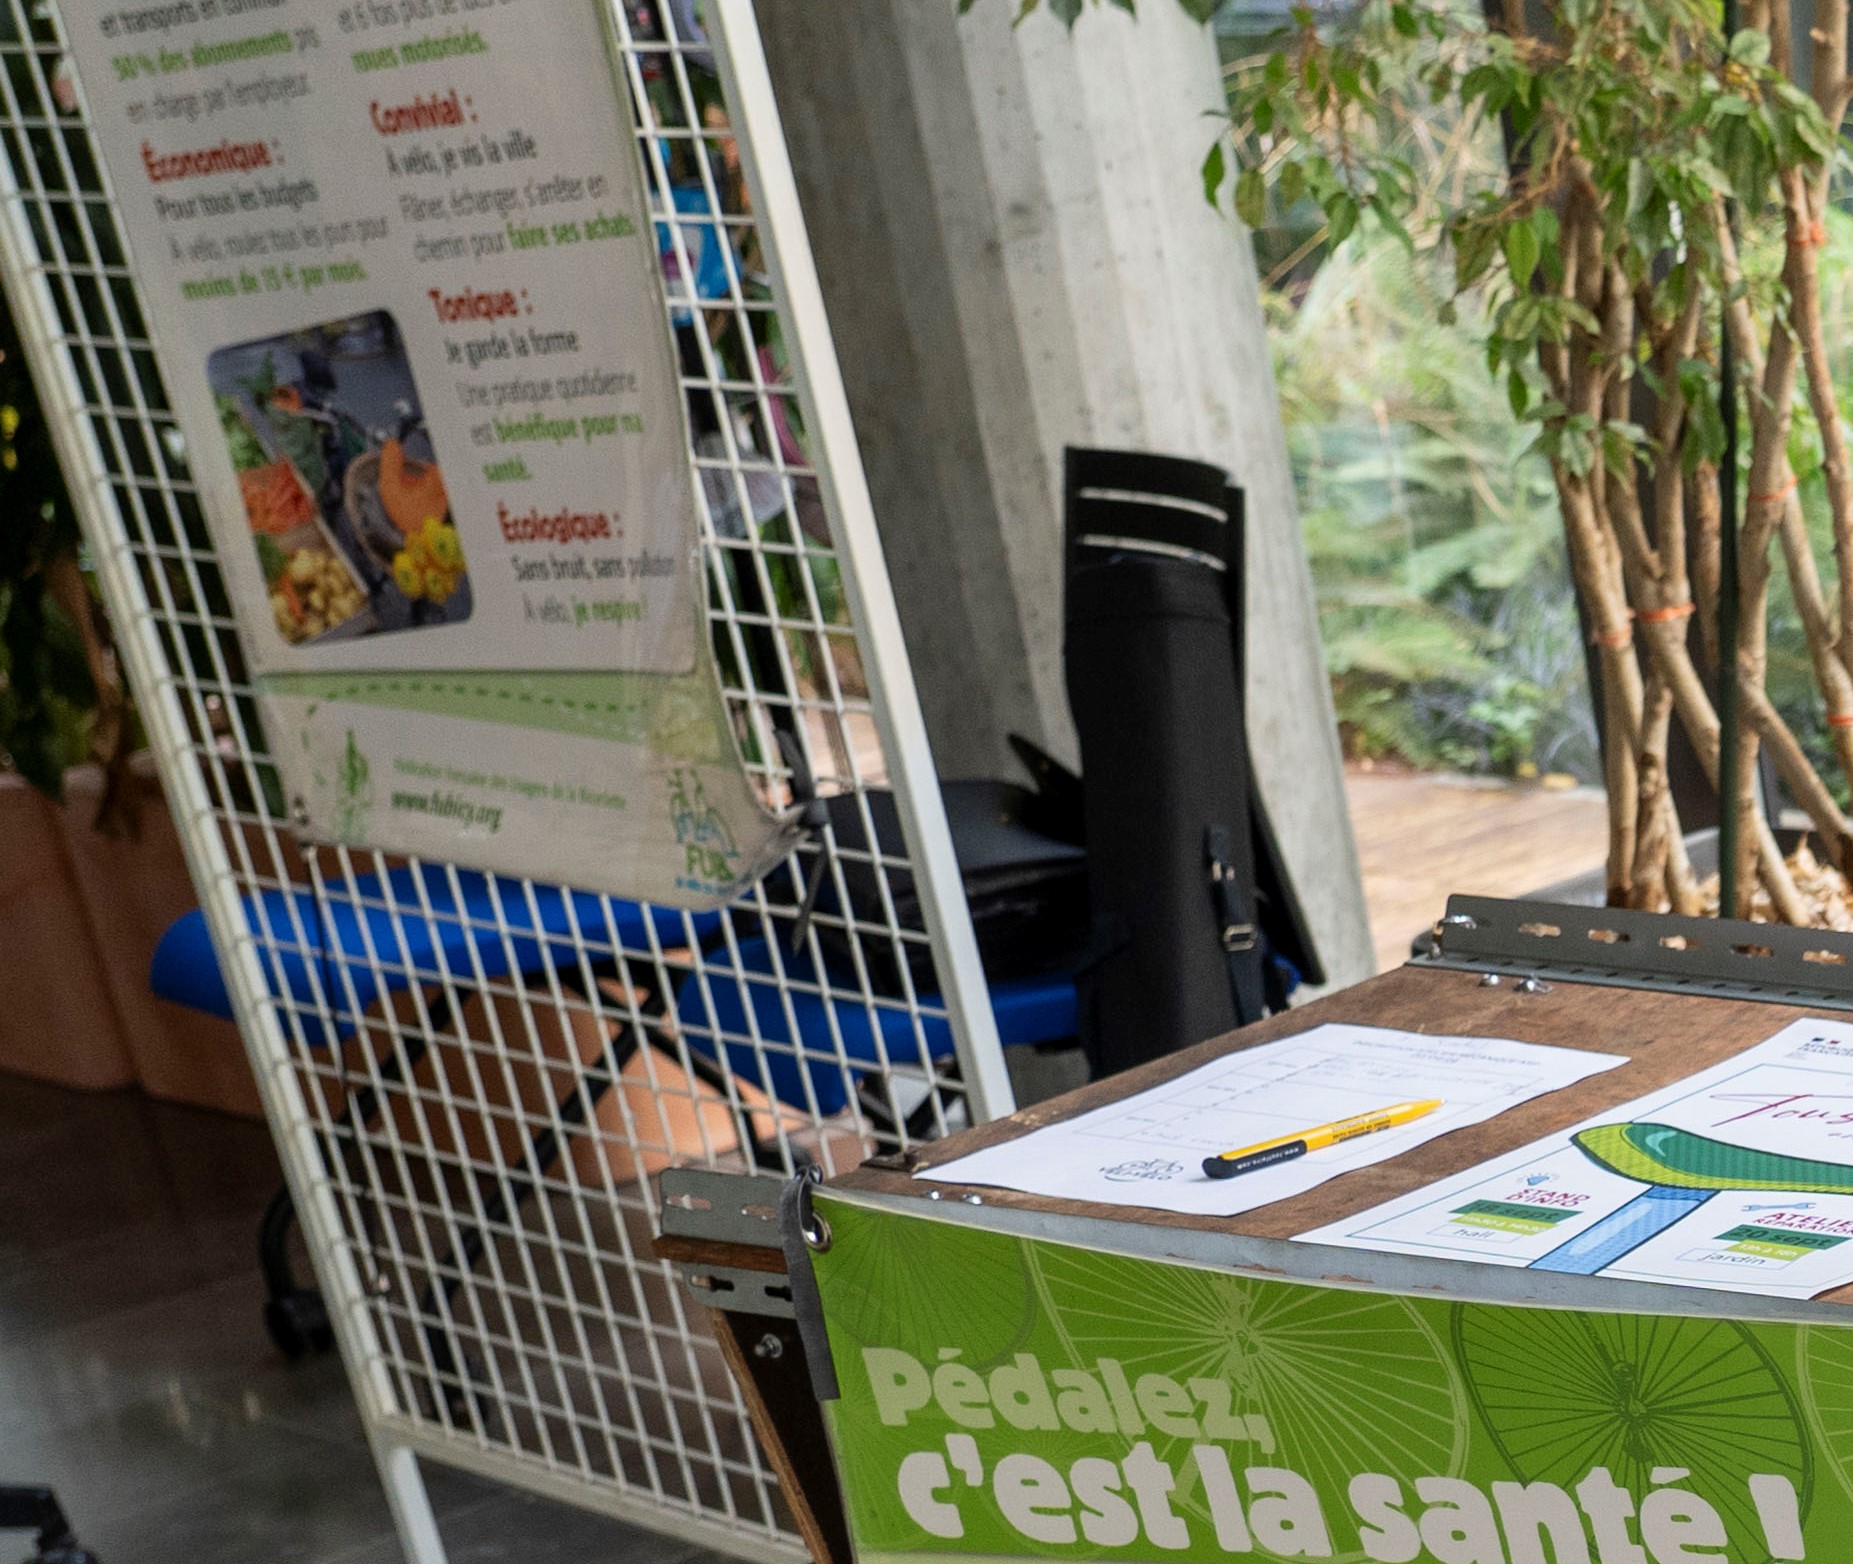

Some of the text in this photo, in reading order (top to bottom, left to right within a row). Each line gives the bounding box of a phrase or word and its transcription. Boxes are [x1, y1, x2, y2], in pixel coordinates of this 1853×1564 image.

[1520, 1188, 1592, 1202] STAND
[1701, 1252, 1766, 1266] jardin
[863, 1347, 1275, 1454] Pédalez,
[898, 1433, 1191, 1550] c'est
[1192, 1443, 1333, 1558] la
